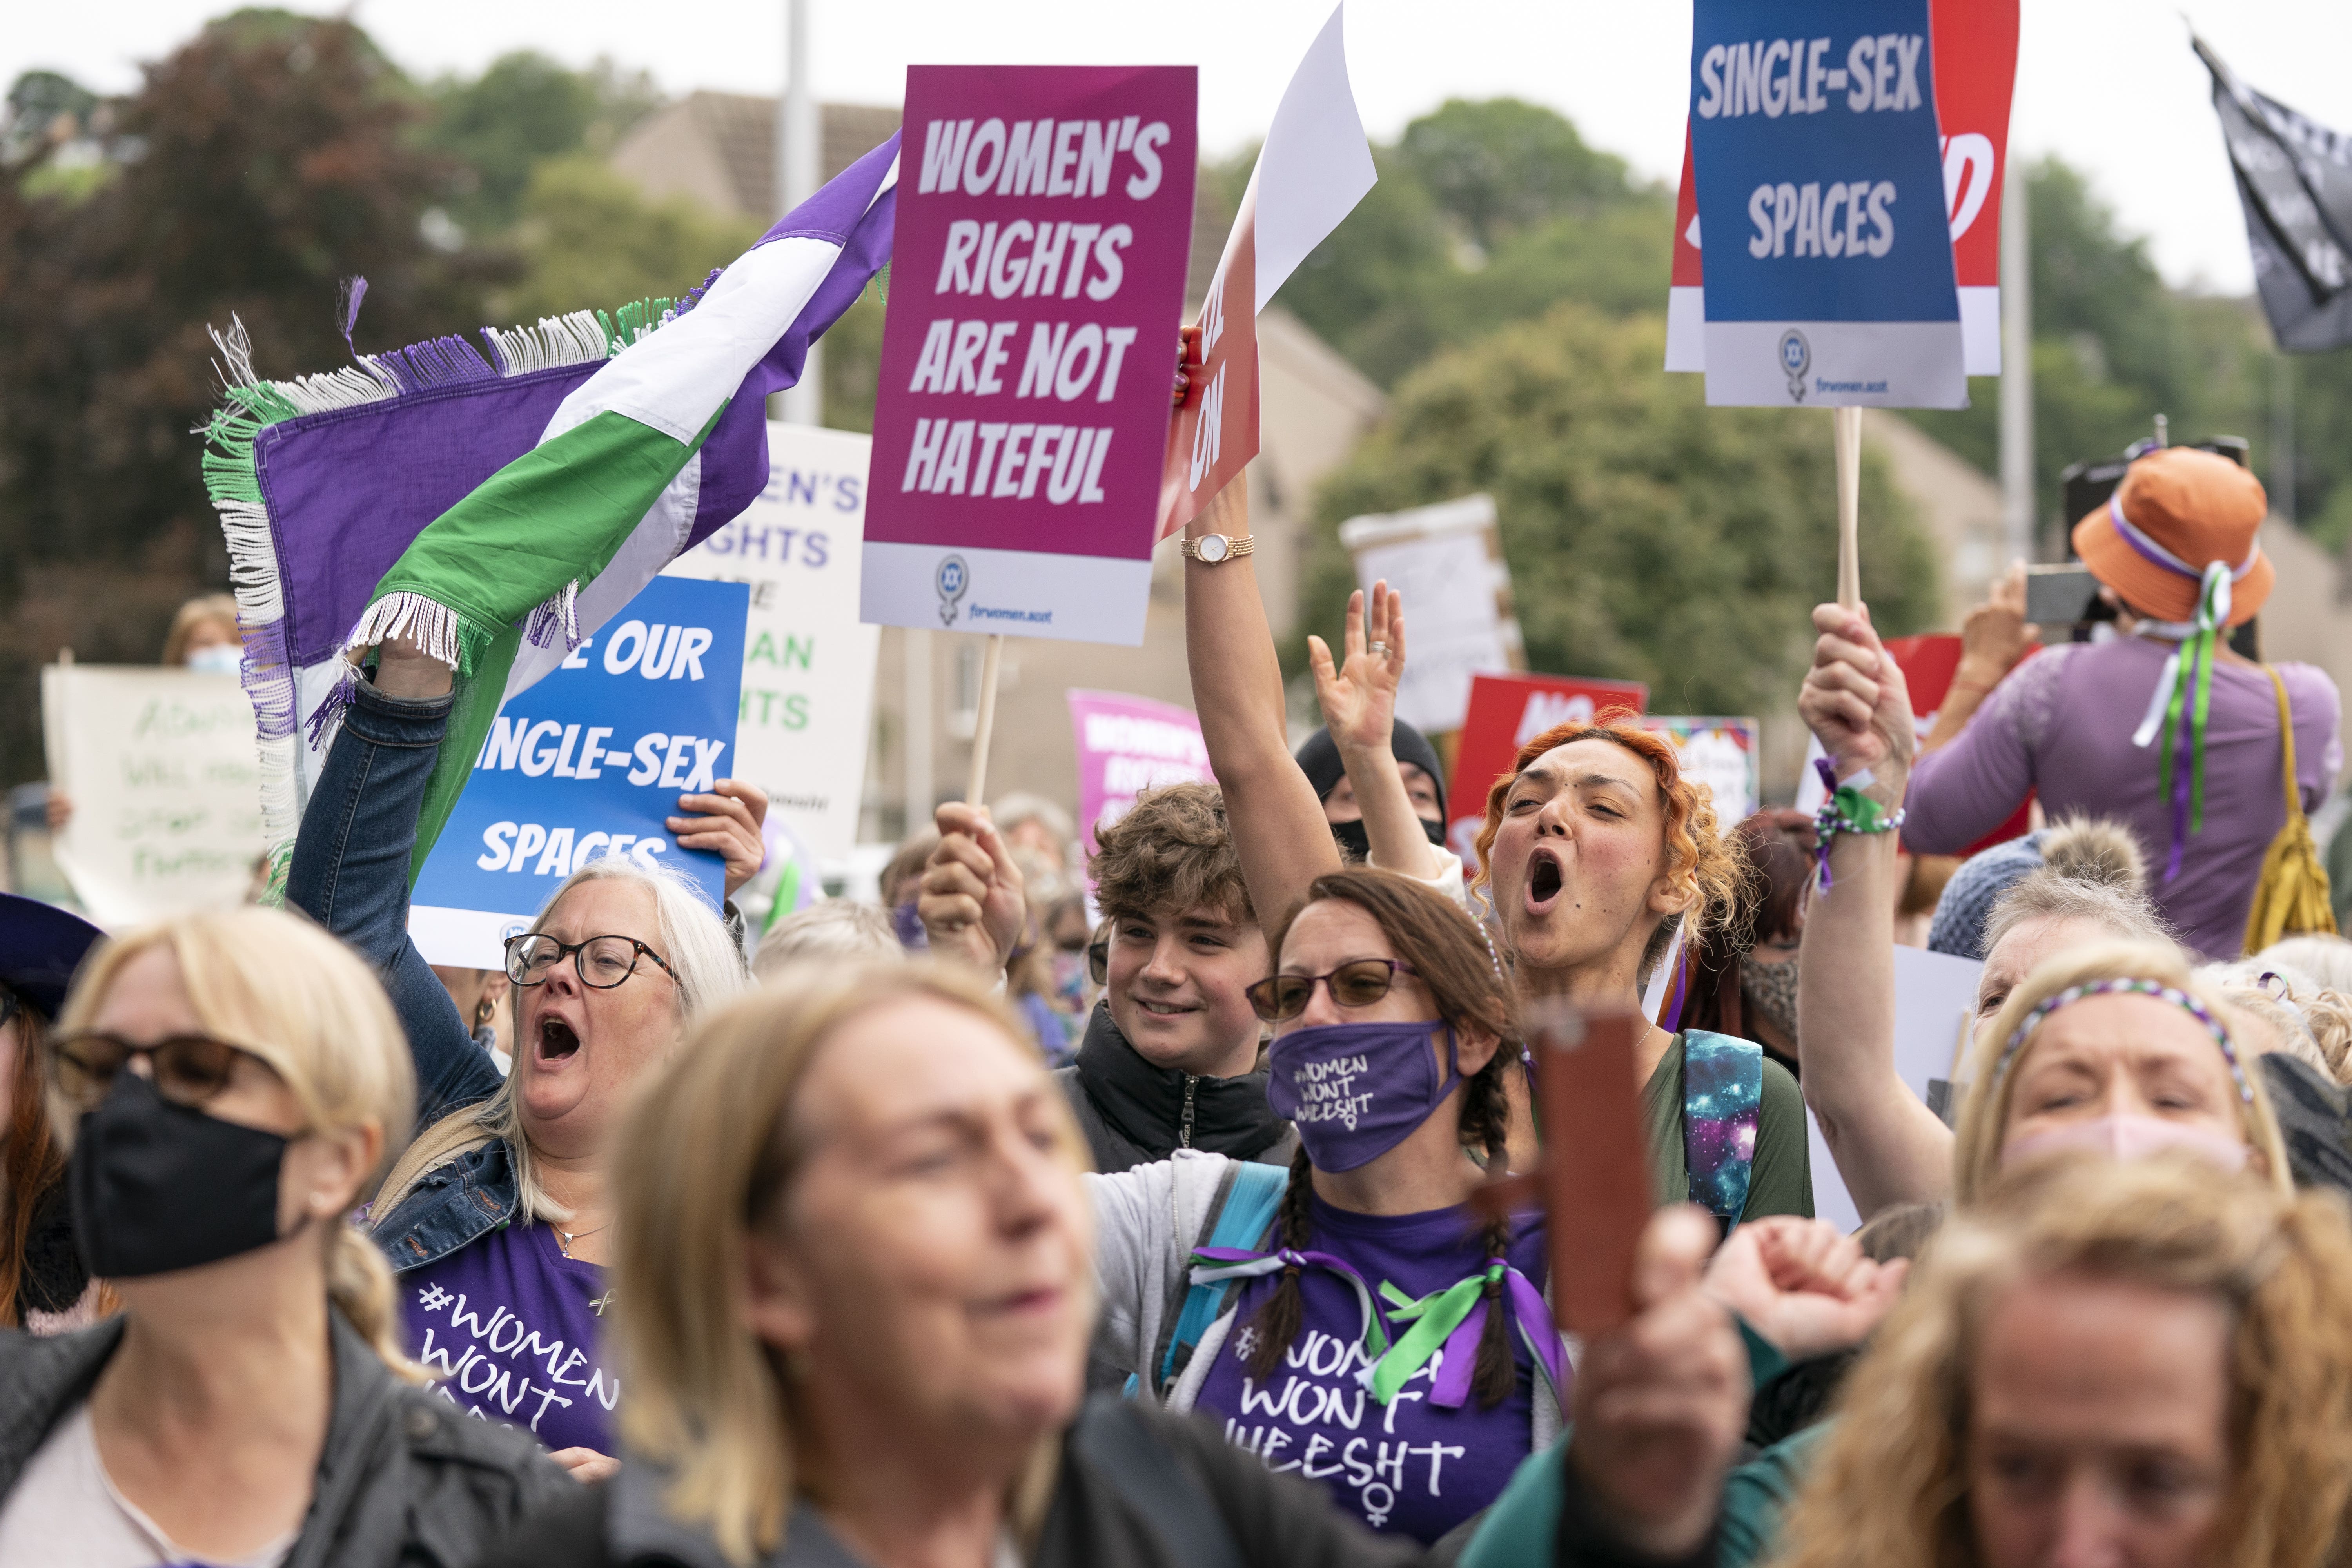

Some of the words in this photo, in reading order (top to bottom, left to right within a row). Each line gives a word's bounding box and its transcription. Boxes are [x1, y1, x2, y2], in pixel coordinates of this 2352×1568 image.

[1697, 34, 1923, 119] SINGLE-SEX
[918, 116, 1170, 200] WOMEN'S
[935, 220, 1132, 301] RIGHTS
[1748, 181, 1896, 259] SPACES
[909, 319, 1018, 396] ARE
[1017, 321, 1138, 403] NOT
[758, 466, 861, 512] EN'S
[902, 418, 1113, 505] HATEFUL
[705, 522, 830, 569] GHTS
[604, 620, 713, 681] OUR
[474, 717, 726, 792] NGLE-SEX
[419, 1282, 619, 1410] #WOMEN
[421, 1328, 573, 1432] WONT
